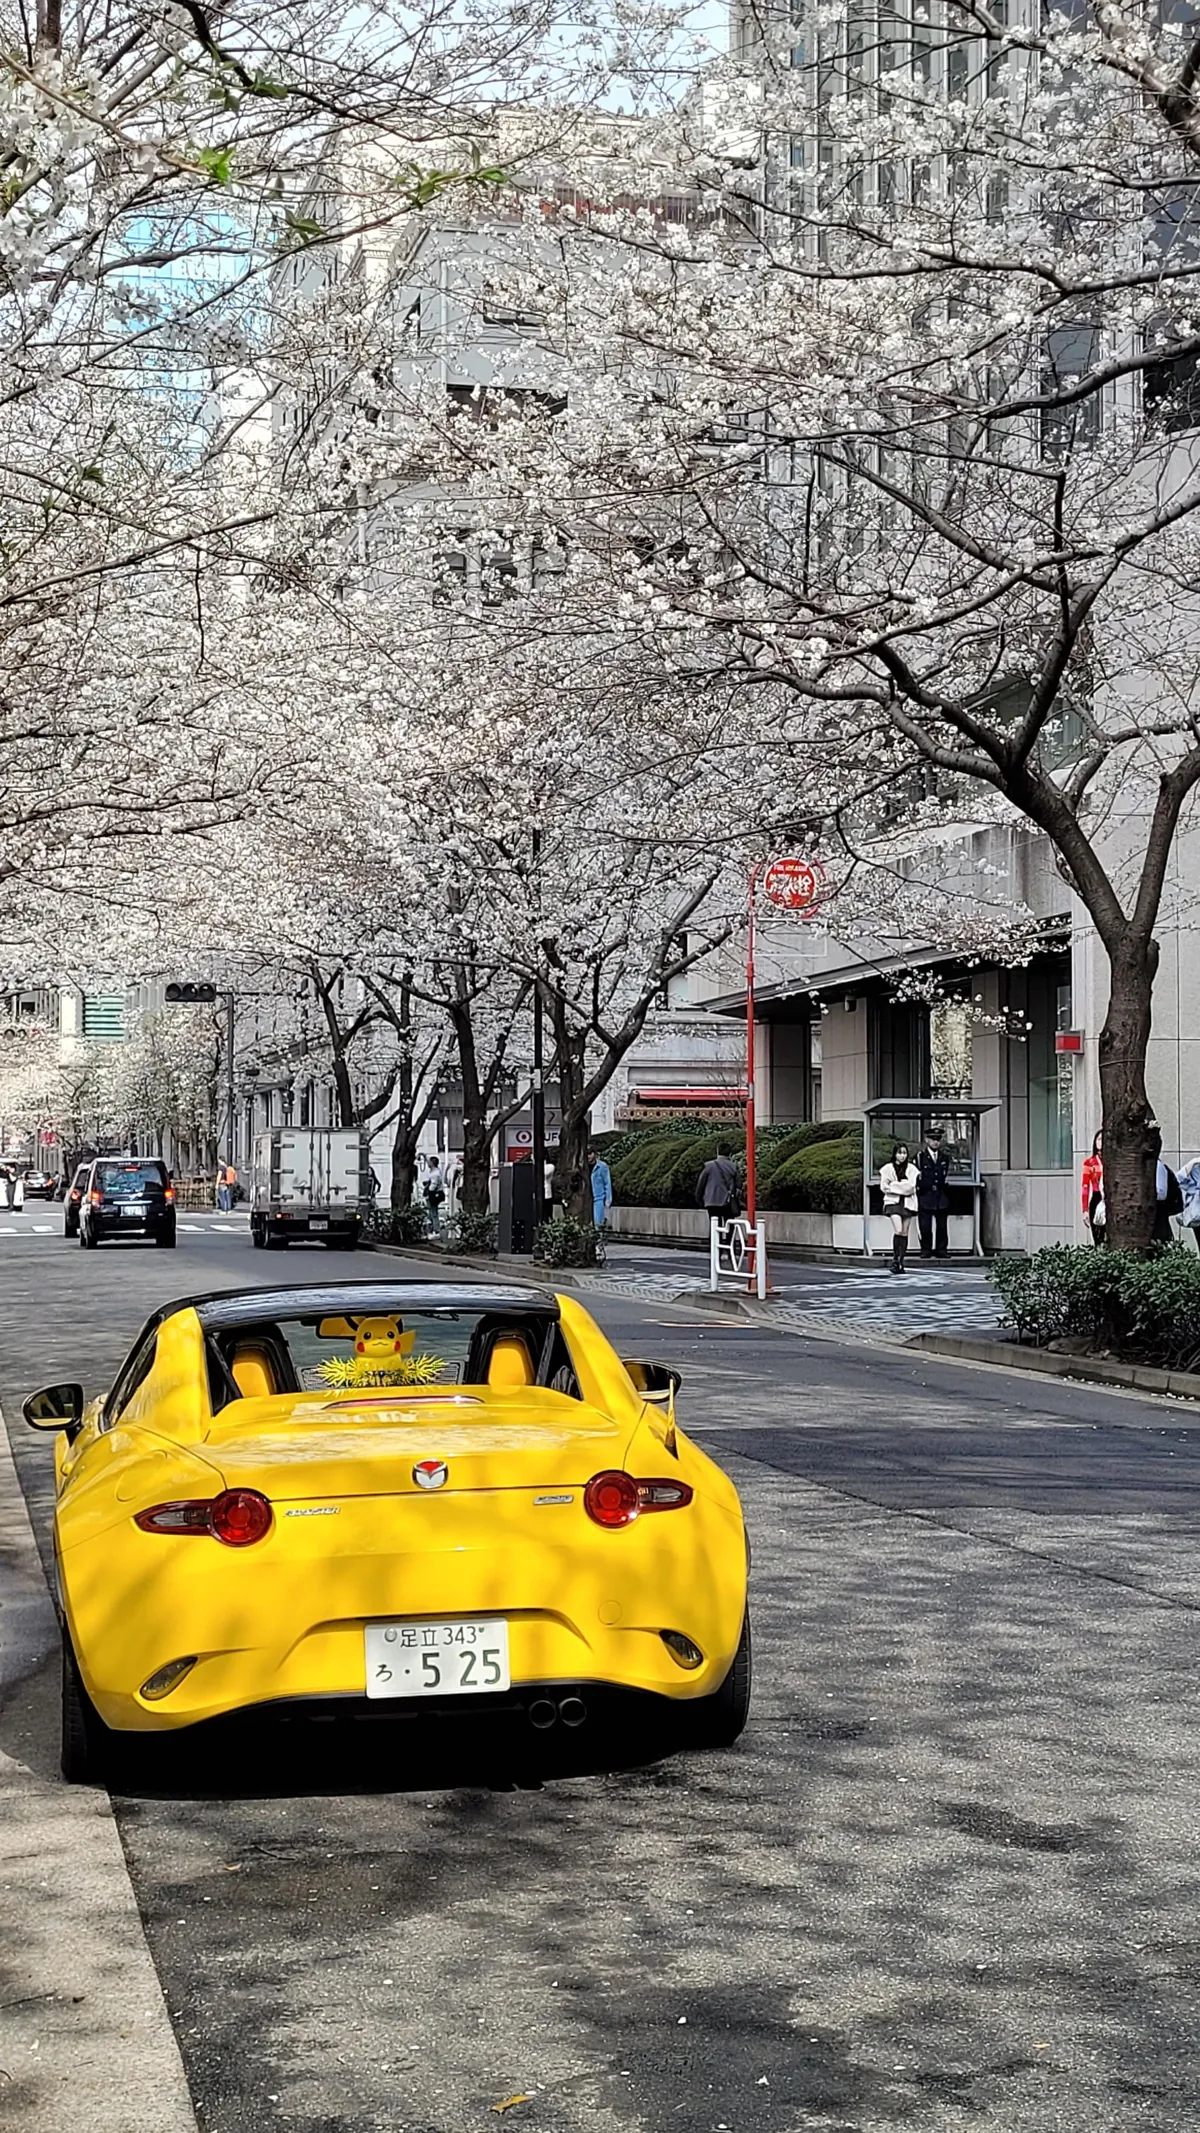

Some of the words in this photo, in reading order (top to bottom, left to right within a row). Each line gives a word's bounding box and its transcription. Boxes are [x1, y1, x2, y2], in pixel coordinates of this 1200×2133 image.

[400, 1628, 439, 1648] 足立
[443, 1626, 477, 1645] 343
[376, 1664, 393, 1682] ろ
[459, 1649, 501, 1686] 25
